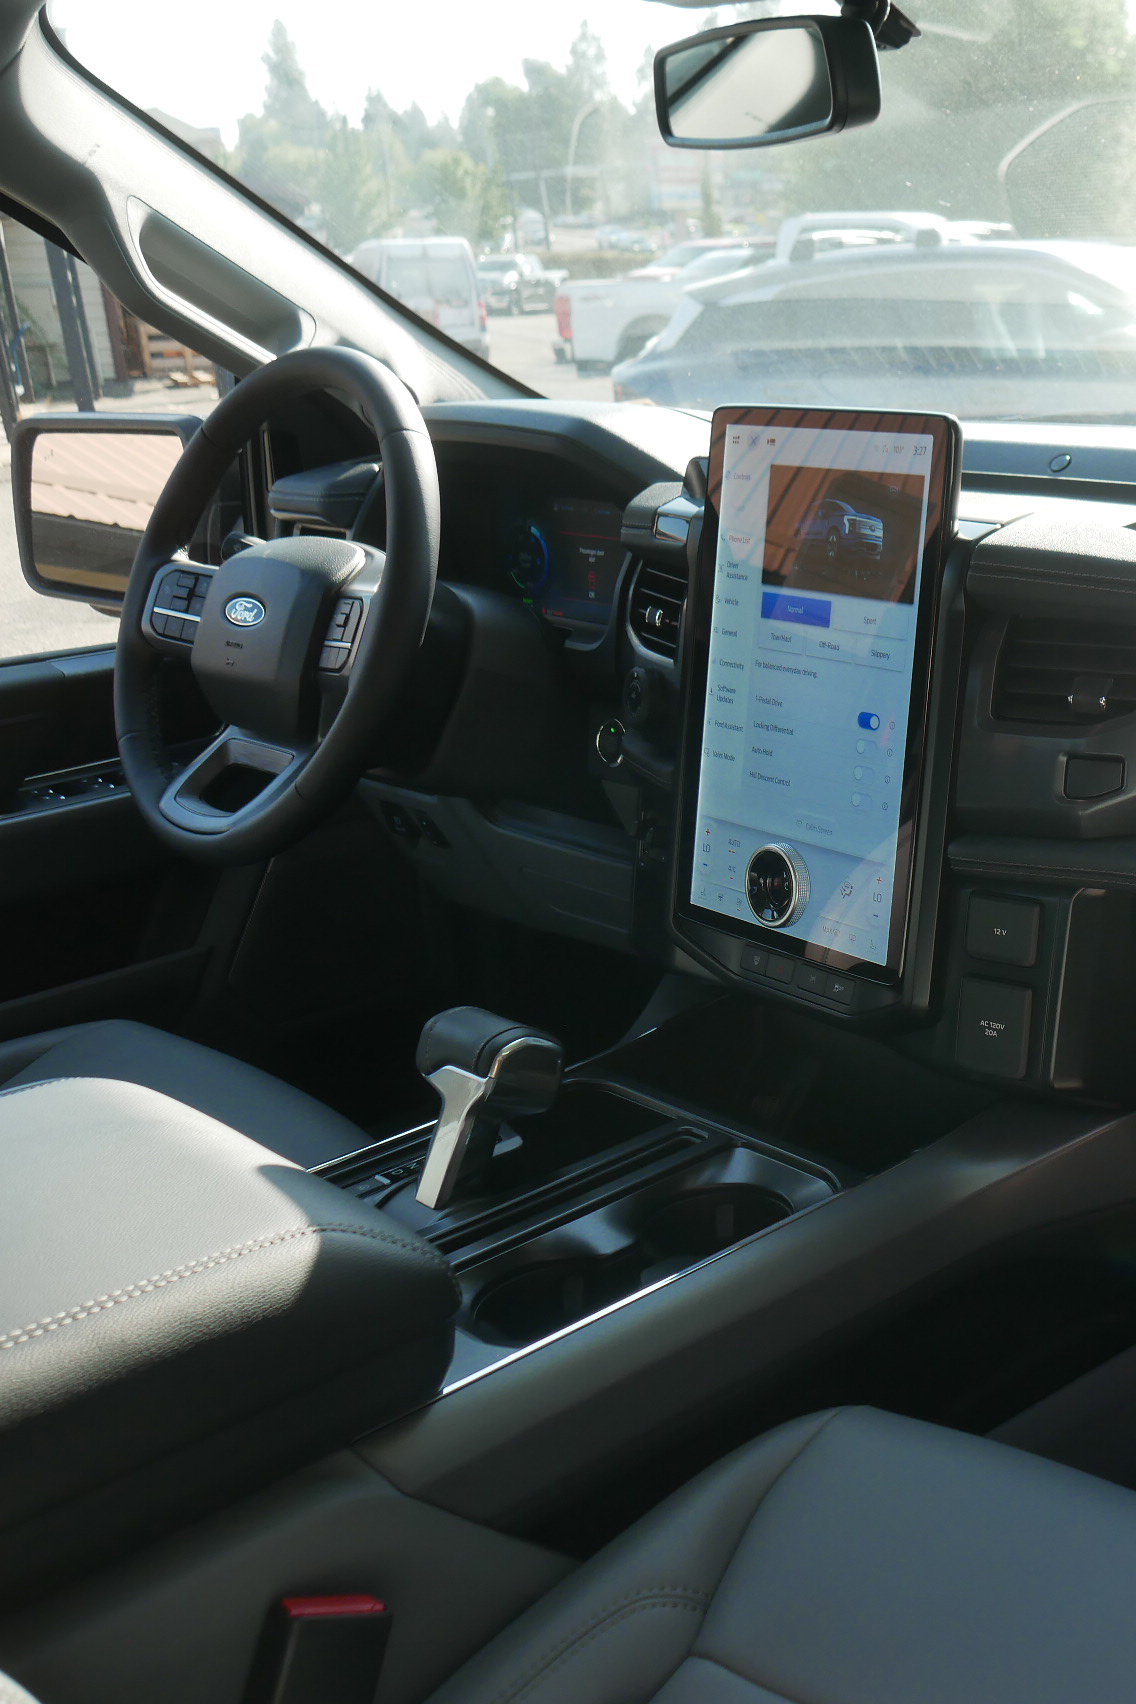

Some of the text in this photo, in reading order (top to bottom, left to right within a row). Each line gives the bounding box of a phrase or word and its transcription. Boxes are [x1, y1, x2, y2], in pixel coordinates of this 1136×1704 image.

[913, 445, 927, 456] 3:27
[870, 649, 891, 662] Slippery
[719, 659, 745, 672] Connectivity
[989, 1021, 1005, 1030] 120V
[985, 1028, 998, 1037] 20A
